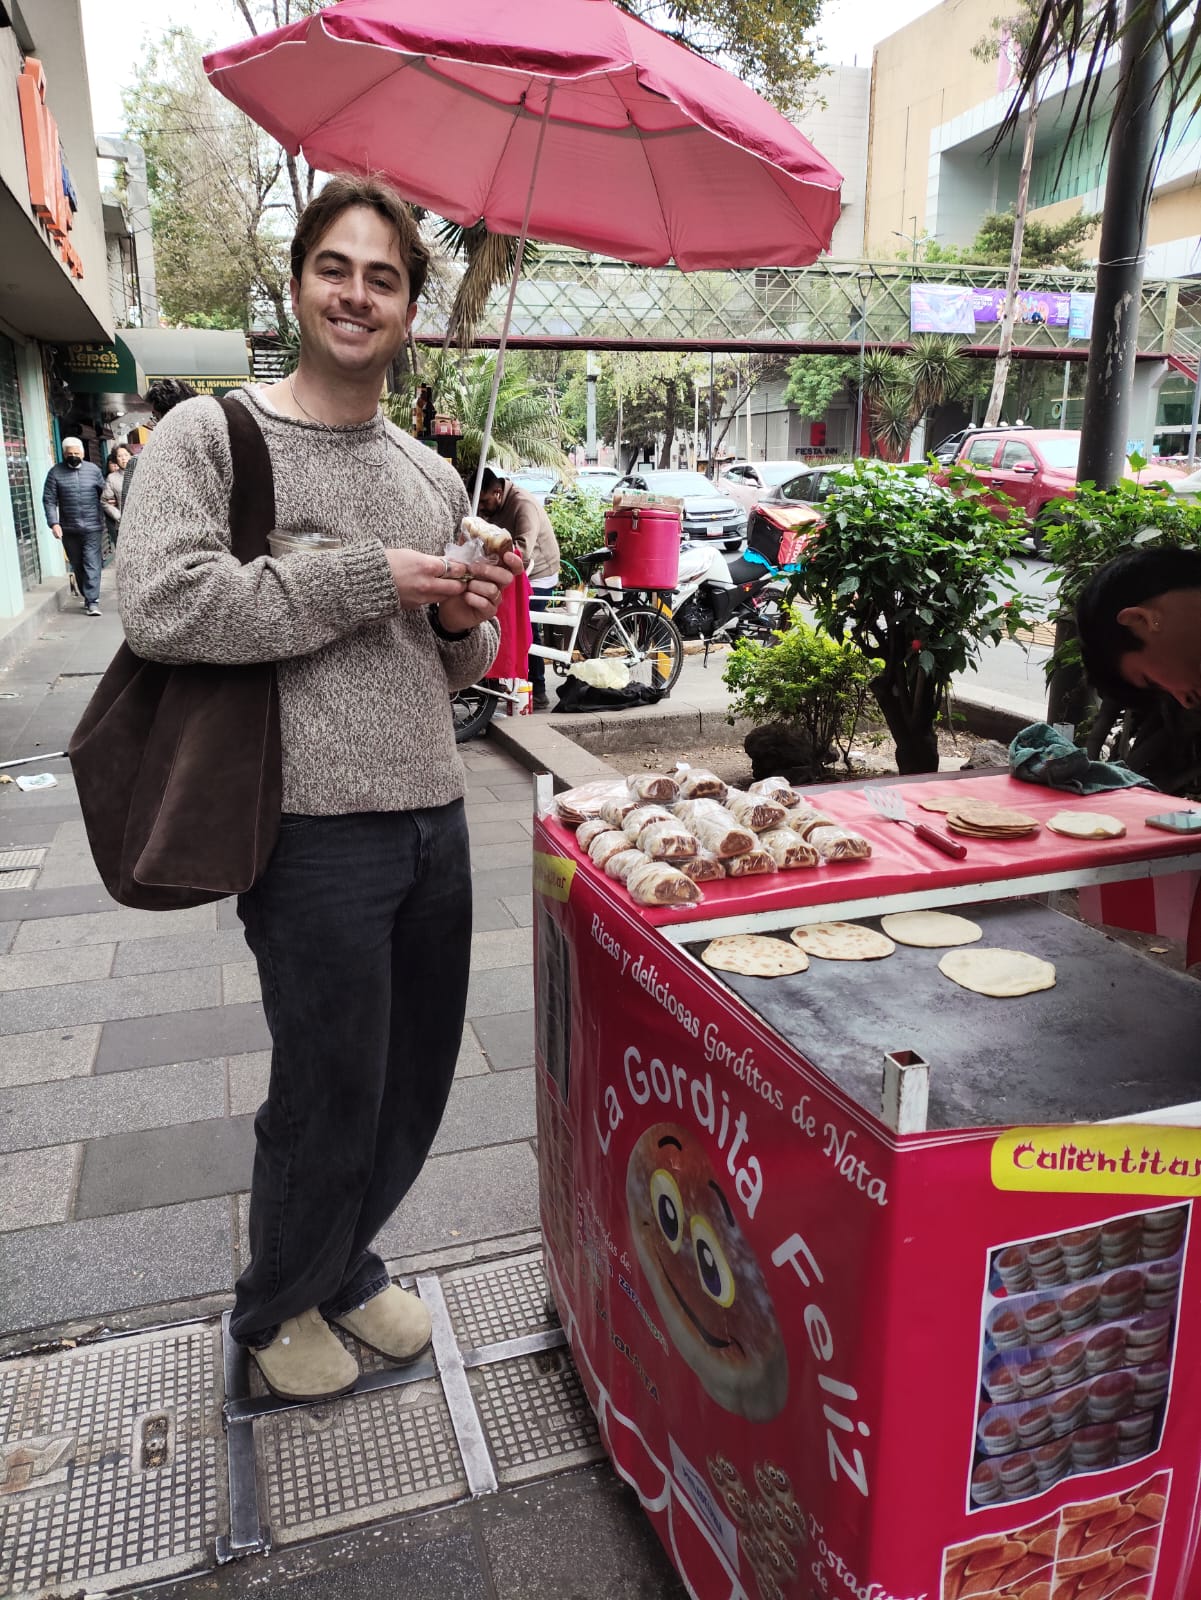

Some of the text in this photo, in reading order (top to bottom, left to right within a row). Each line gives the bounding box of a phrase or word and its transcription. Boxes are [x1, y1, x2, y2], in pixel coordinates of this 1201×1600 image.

[795, 447, 823, 456] FIESTA
[590, 912, 622, 963] Ricas
[620, 952, 633, 977] y
[631, 955, 701, 1038] deliciosas
[790, 1095, 817, 1139] de
[823, 1122, 890, 1207] Nata
[1013, 1140, 1201, 1177] Calientitas
[592, 1084, 624, 1157] La
[623, 1045, 764, 1221] Gordita
[771, 1232, 871, 1498] Feliz
